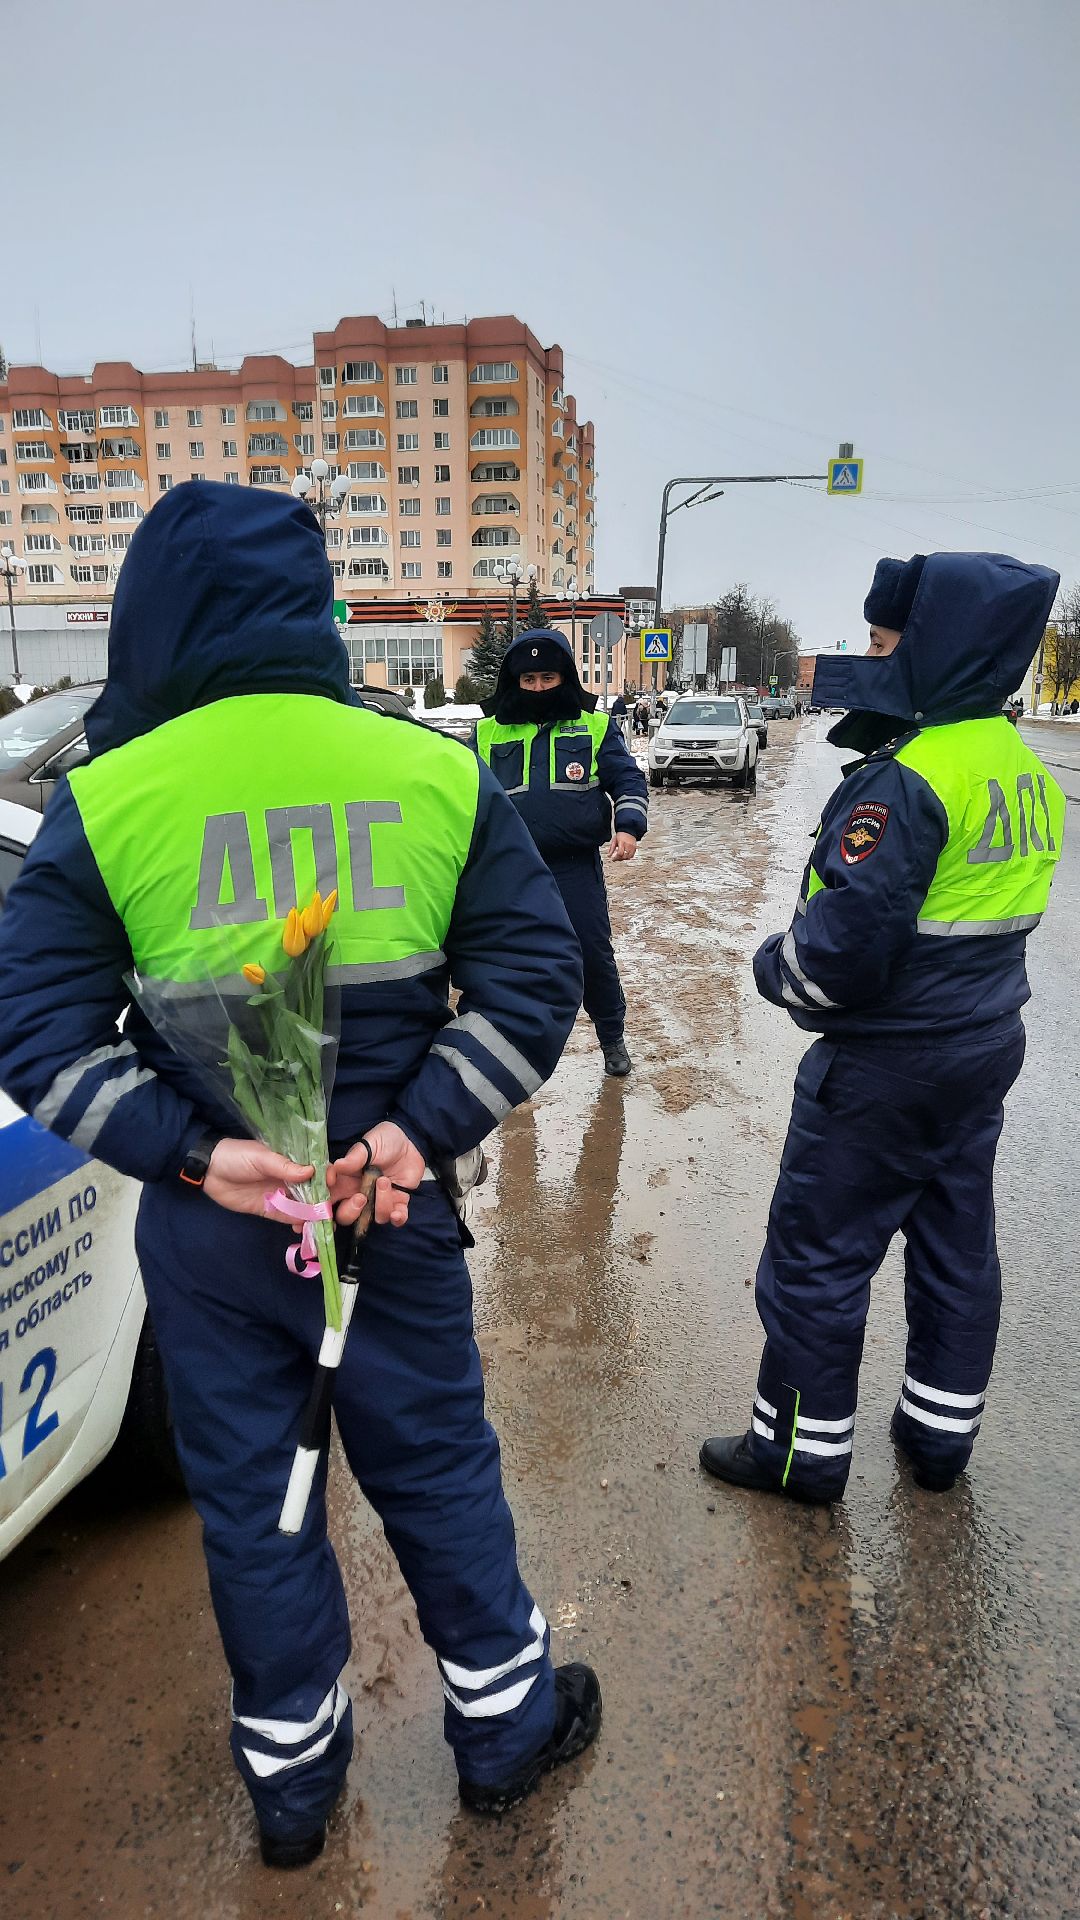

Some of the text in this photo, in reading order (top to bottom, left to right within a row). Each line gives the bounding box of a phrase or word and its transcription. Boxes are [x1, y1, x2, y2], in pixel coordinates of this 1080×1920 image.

[68, 613, 93, 621] КУХНИ
[855, 804, 887, 816] ПОЛИЦИЯ
[851, 817, 881, 830] РОССИЯ
[188, 800, 406, 930] ДПС
[74, 1232, 93, 1258] го
[15, 1271, 93, 1338] область
[0, 1346, 59, 1478] 2
